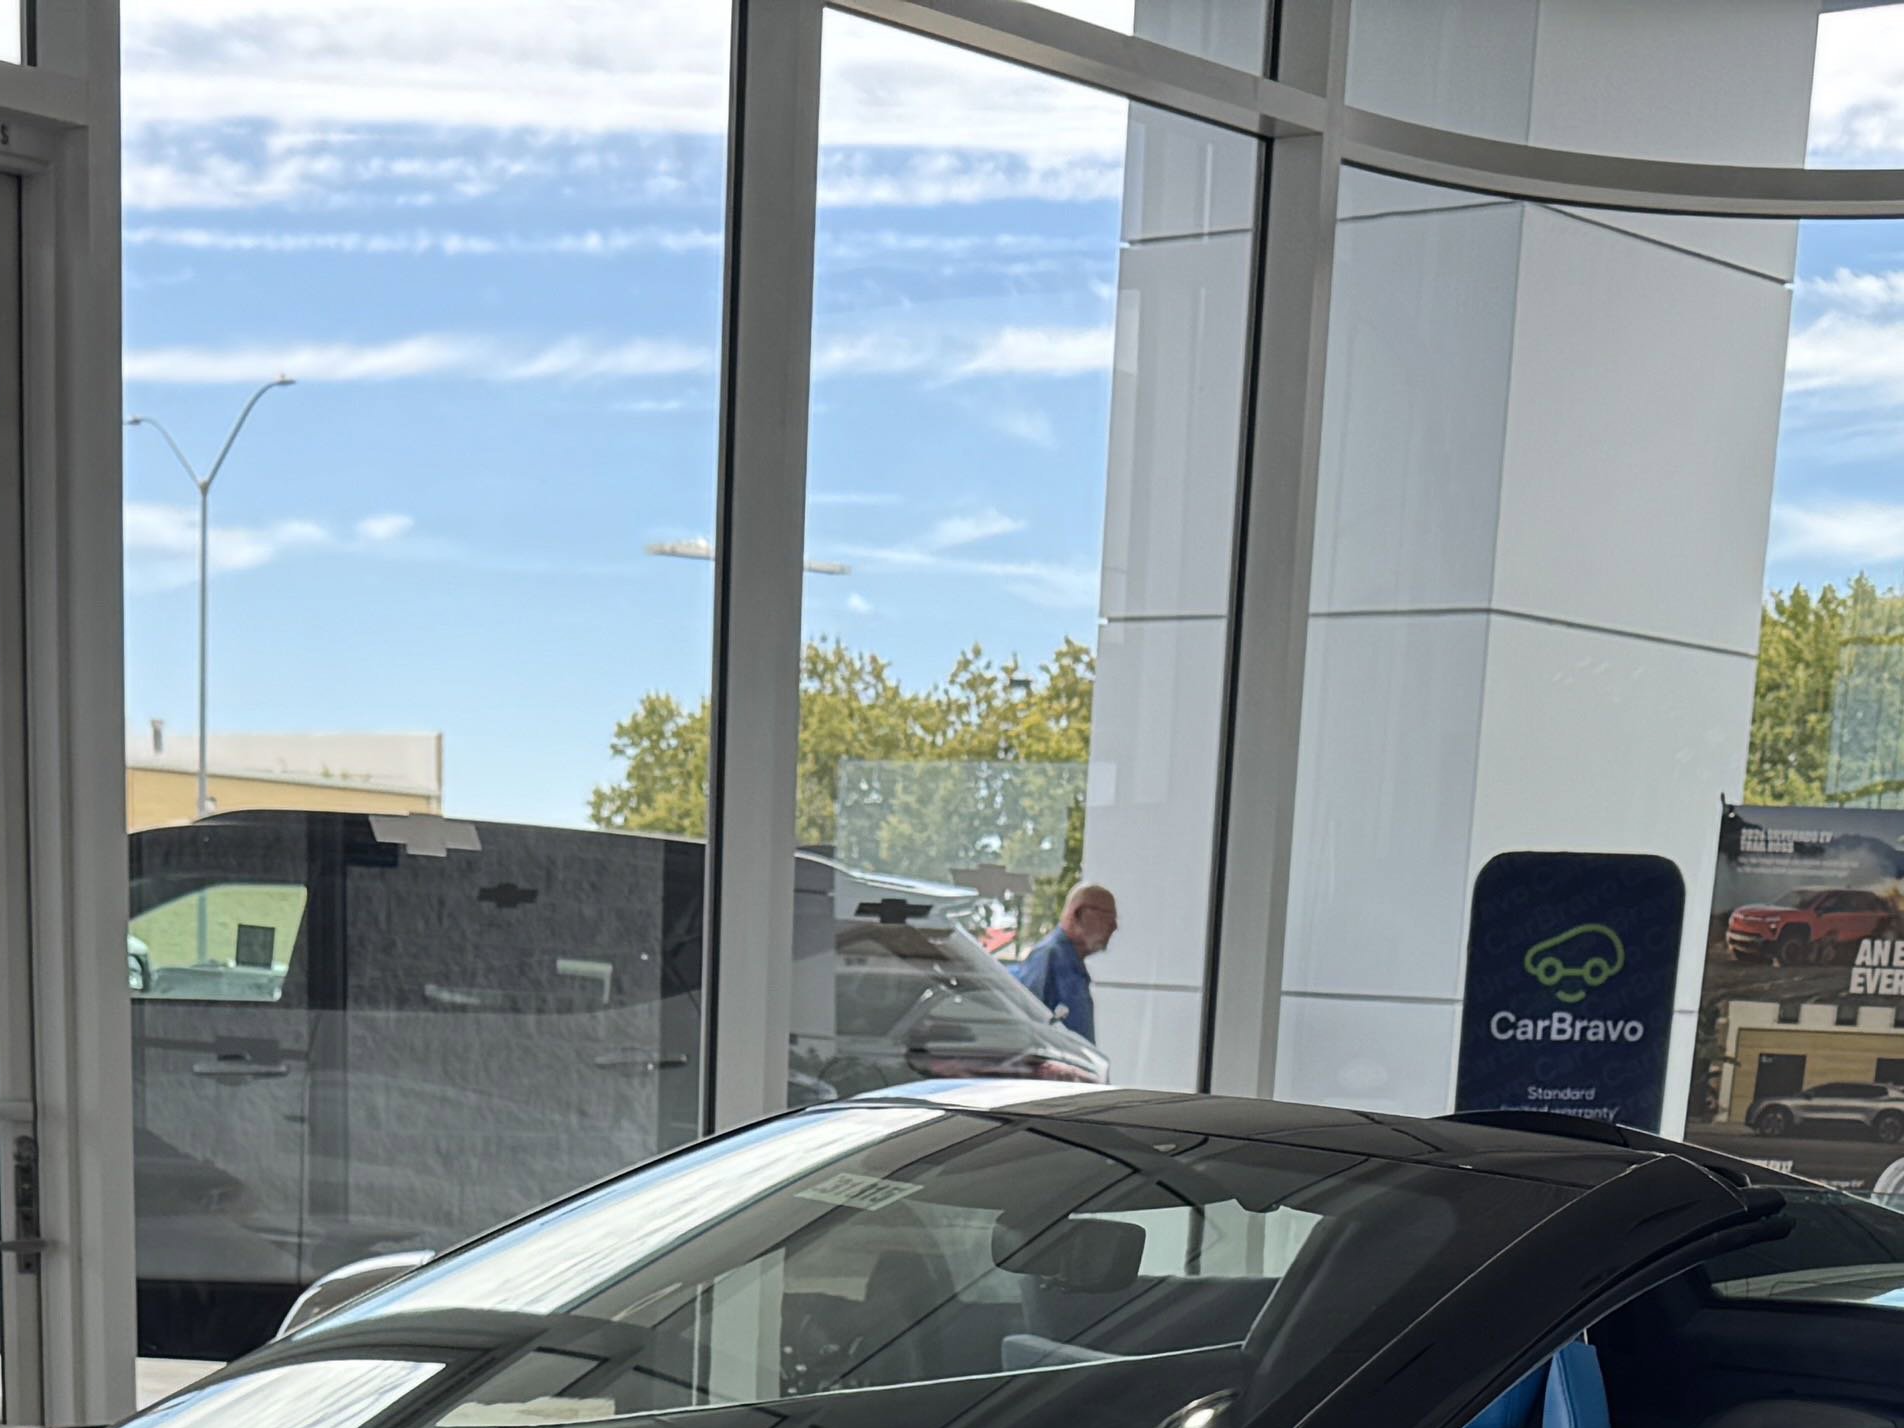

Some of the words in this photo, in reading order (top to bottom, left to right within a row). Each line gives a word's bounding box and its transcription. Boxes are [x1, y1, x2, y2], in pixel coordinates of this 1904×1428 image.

[1855, 939, 1892, 968] AN
[1490, 1010, 1645, 1043] CarBravo
[1527, 1085, 1596, 1101] Standard
